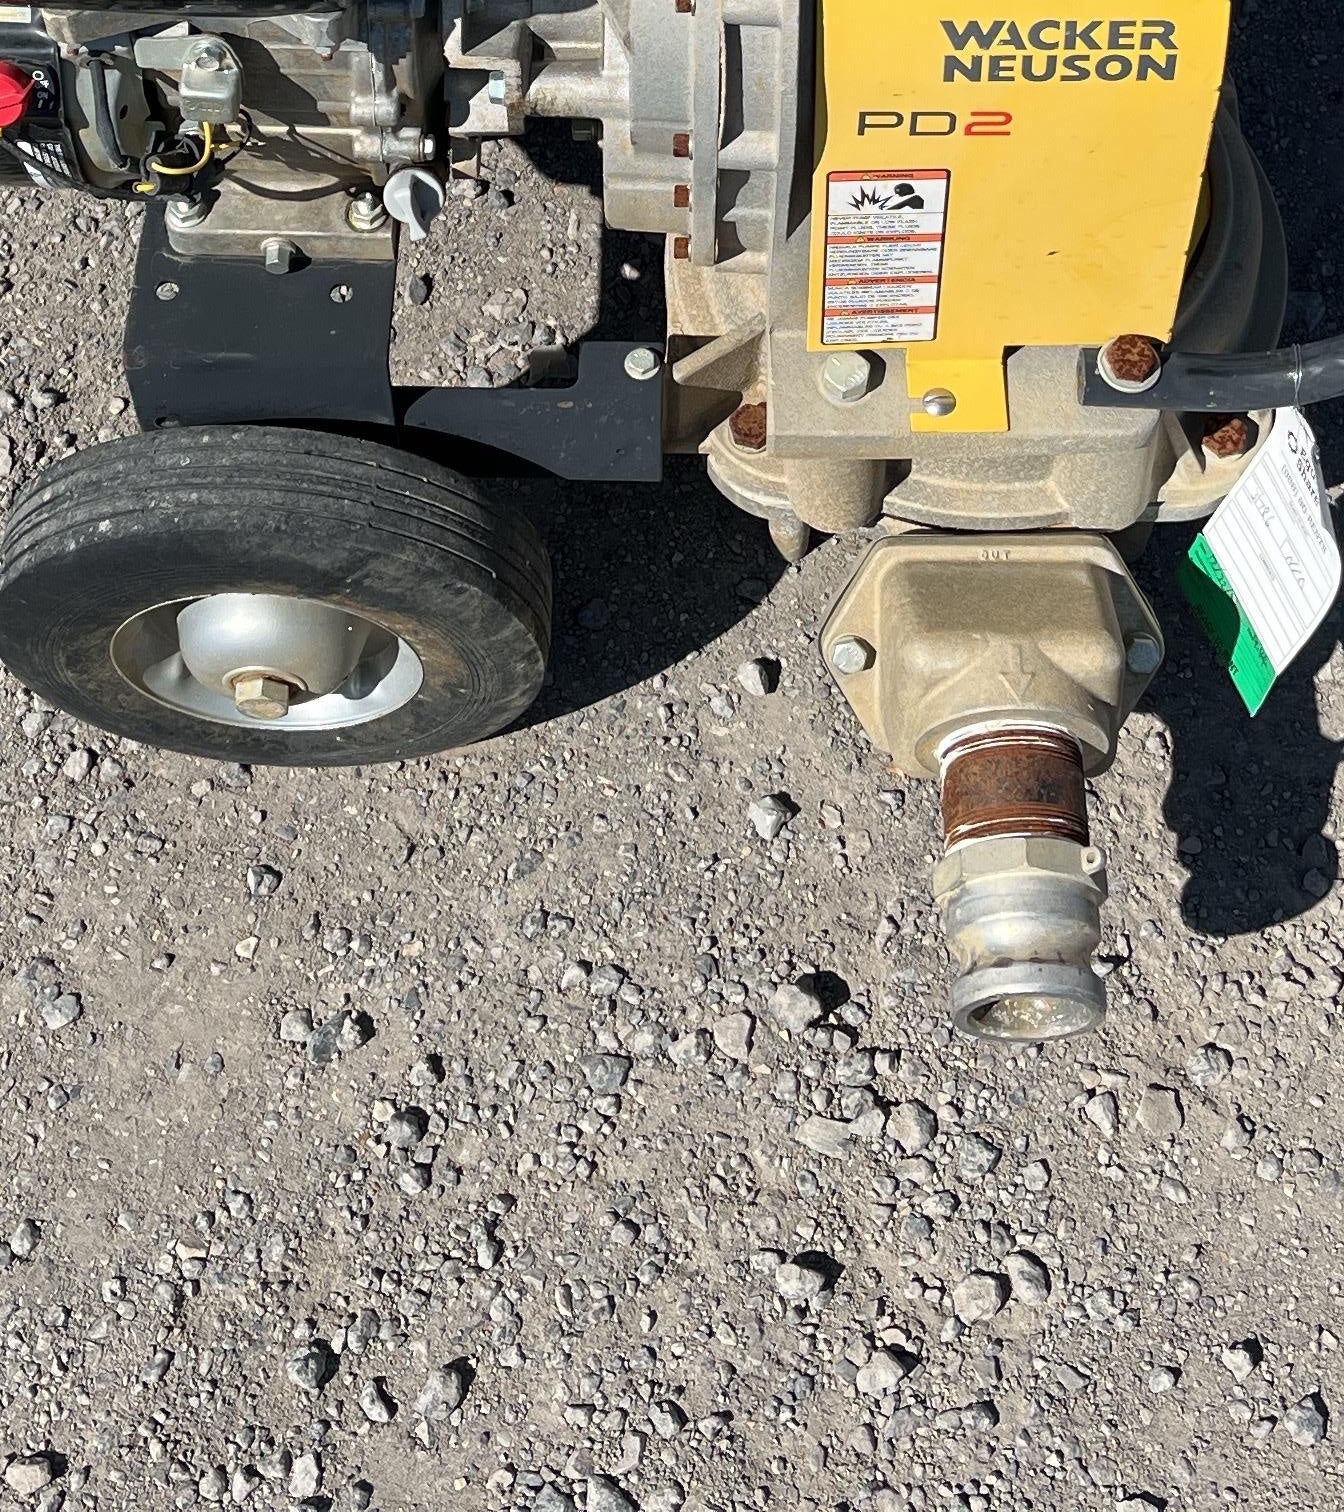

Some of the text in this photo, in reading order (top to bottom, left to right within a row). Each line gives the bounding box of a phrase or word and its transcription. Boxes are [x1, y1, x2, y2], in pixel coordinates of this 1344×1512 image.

[940, 19, 1179, 50] WACKER
[943, 54, 1178, 82] NEUSON
[857, 111, 1013, 136] PD2
[977, 548, 1011, 561] OUT
